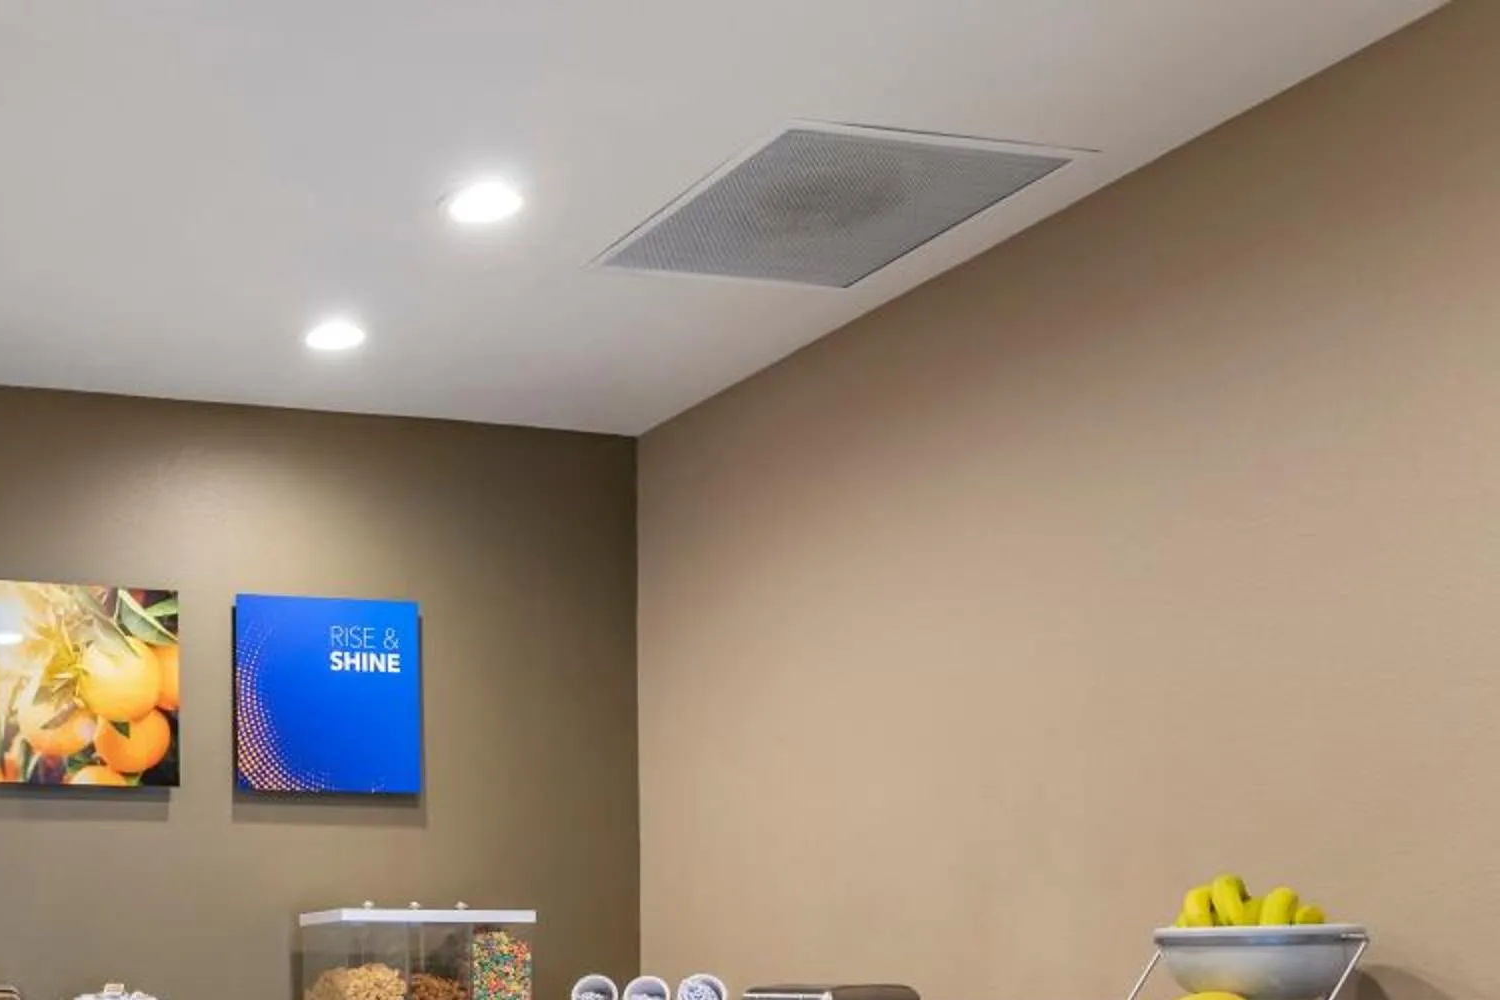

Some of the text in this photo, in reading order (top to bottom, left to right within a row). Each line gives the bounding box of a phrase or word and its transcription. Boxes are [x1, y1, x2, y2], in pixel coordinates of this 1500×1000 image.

[331, 625, 400, 650] RISE &
[330, 650, 401, 673] SHINE
